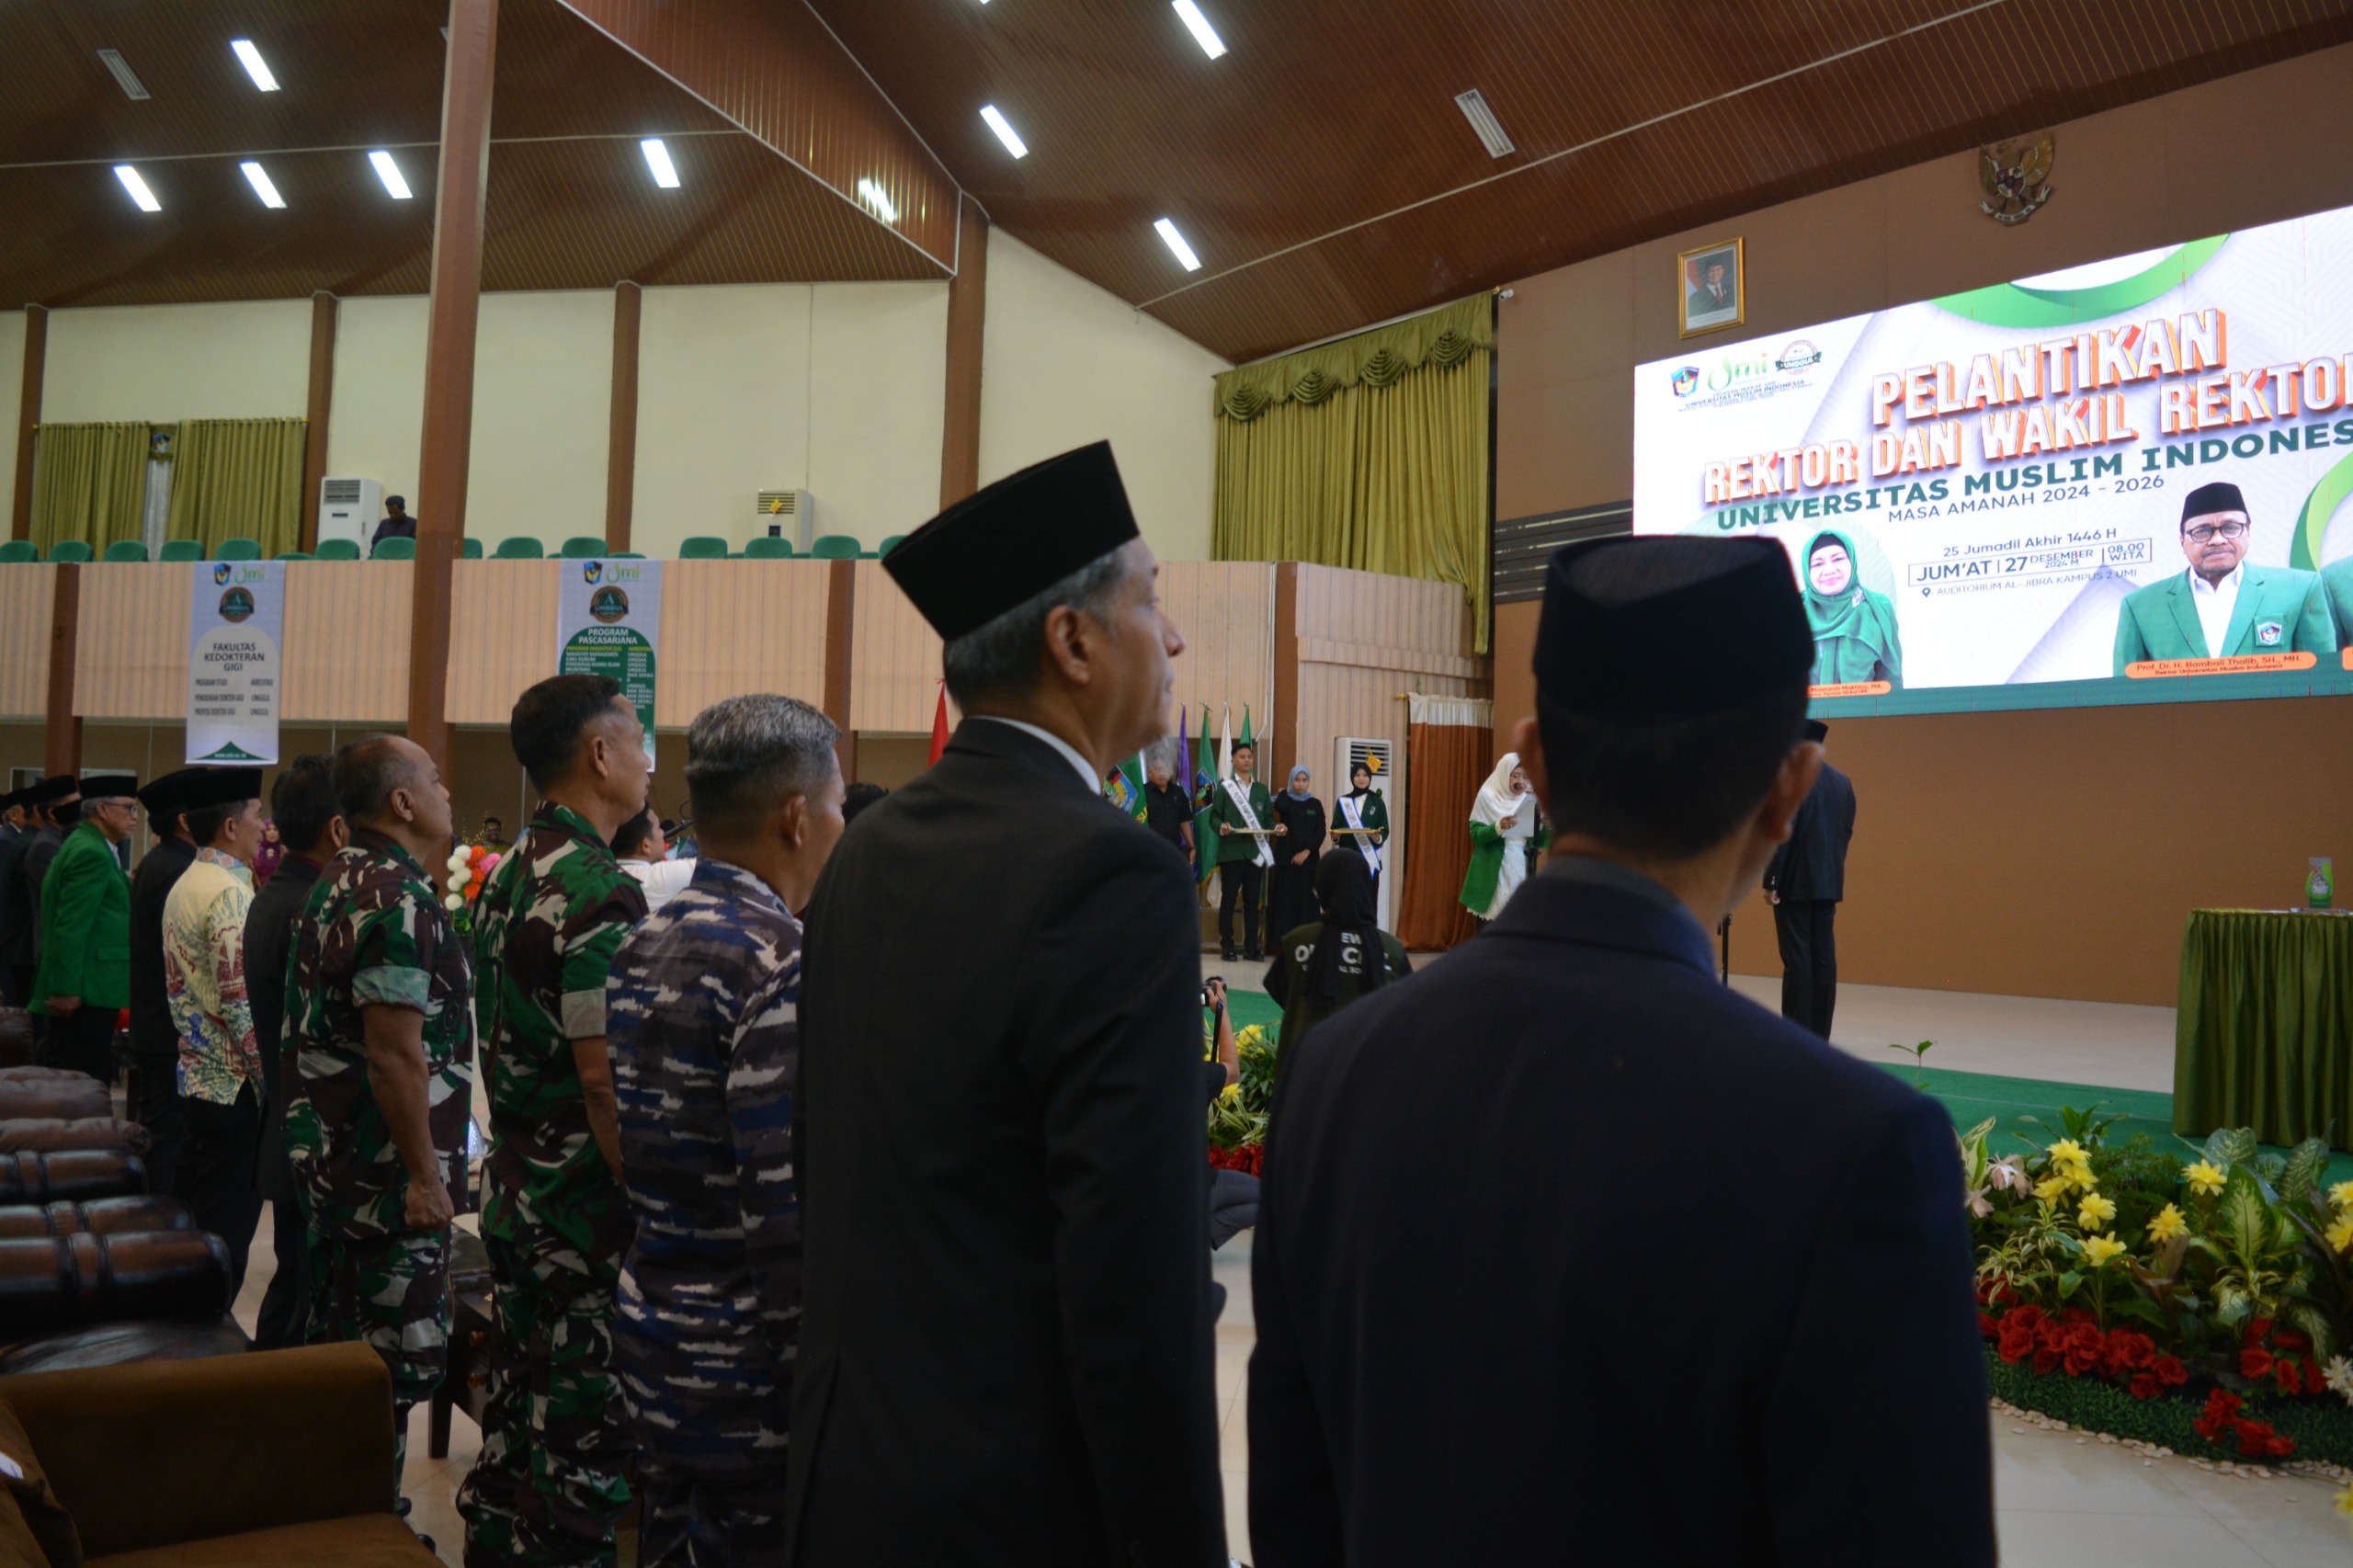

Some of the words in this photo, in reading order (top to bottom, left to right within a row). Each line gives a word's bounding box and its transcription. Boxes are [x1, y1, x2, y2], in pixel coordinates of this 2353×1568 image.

[1872, 308, 2226, 427] PELANTIKAN
[1686, 395, 1732, 408] UNIVERSITAS
[1733, 387, 1762, 399] MUSLIM
[1764, 379, 1805, 392] INDONESIA
[1703, 438, 1859, 505] REKTOR
[1871, 419, 1962, 478] DAN
[1980, 392, 2140, 461] WAKIL
[1718, 478, 1949, 530] UNIVERSITAS
[1965, 453, 2122, 496] MUSLIM
[1889, 503, 1941, 523] MASA
[1948, 484, 2035, 516] AMANAH
[2042, 483, 2090, 503] 2024
[2115, 475, 2165, 494] 2026
[1944, 546, 1960, 557] 25
[1964, 540, 2021, 555] Jumadil
[2025, 534, 2063, 549] Akhir
[2067, 530, 2102, 543] 1446
[2106, 528, 2117, 539] H
[1916, 560, 1993, 582] JUM'AT
[2005, 556, 2029, 573] 27
[2030, 549, 2094, 563] DESEMBER
[2108, 542, 2145, 553] 08.00
[2045, 559, 2068, 568] 2024
[2071, 558, 2079, 566] M
[2109, 551, 2144, 562] WITA
[1937, 581, 2002, 596] AUDITORIUM
[2005, 576, 2054, 589] AL-JIBRA
[2056, 571, 2104, 585] KAMPUS
[2106, 571, 2113, 580] 2
[2116, 568, 2138, 578] UMI
[578, 636, 638, 644] PASCASARJANA
[587, 628, 629, 636] PROGRAM
[204, 653, 266, 662] KEDOKTERAN
[213, 642, 256, 652] FAKULTAS
[223, 663, 244, 671] GIGI
[2186, 660, 2225, 668] Hambali
[2228, 657, 2259, 666] Thalib,
[2284, 654, 2302, 663] MH.
